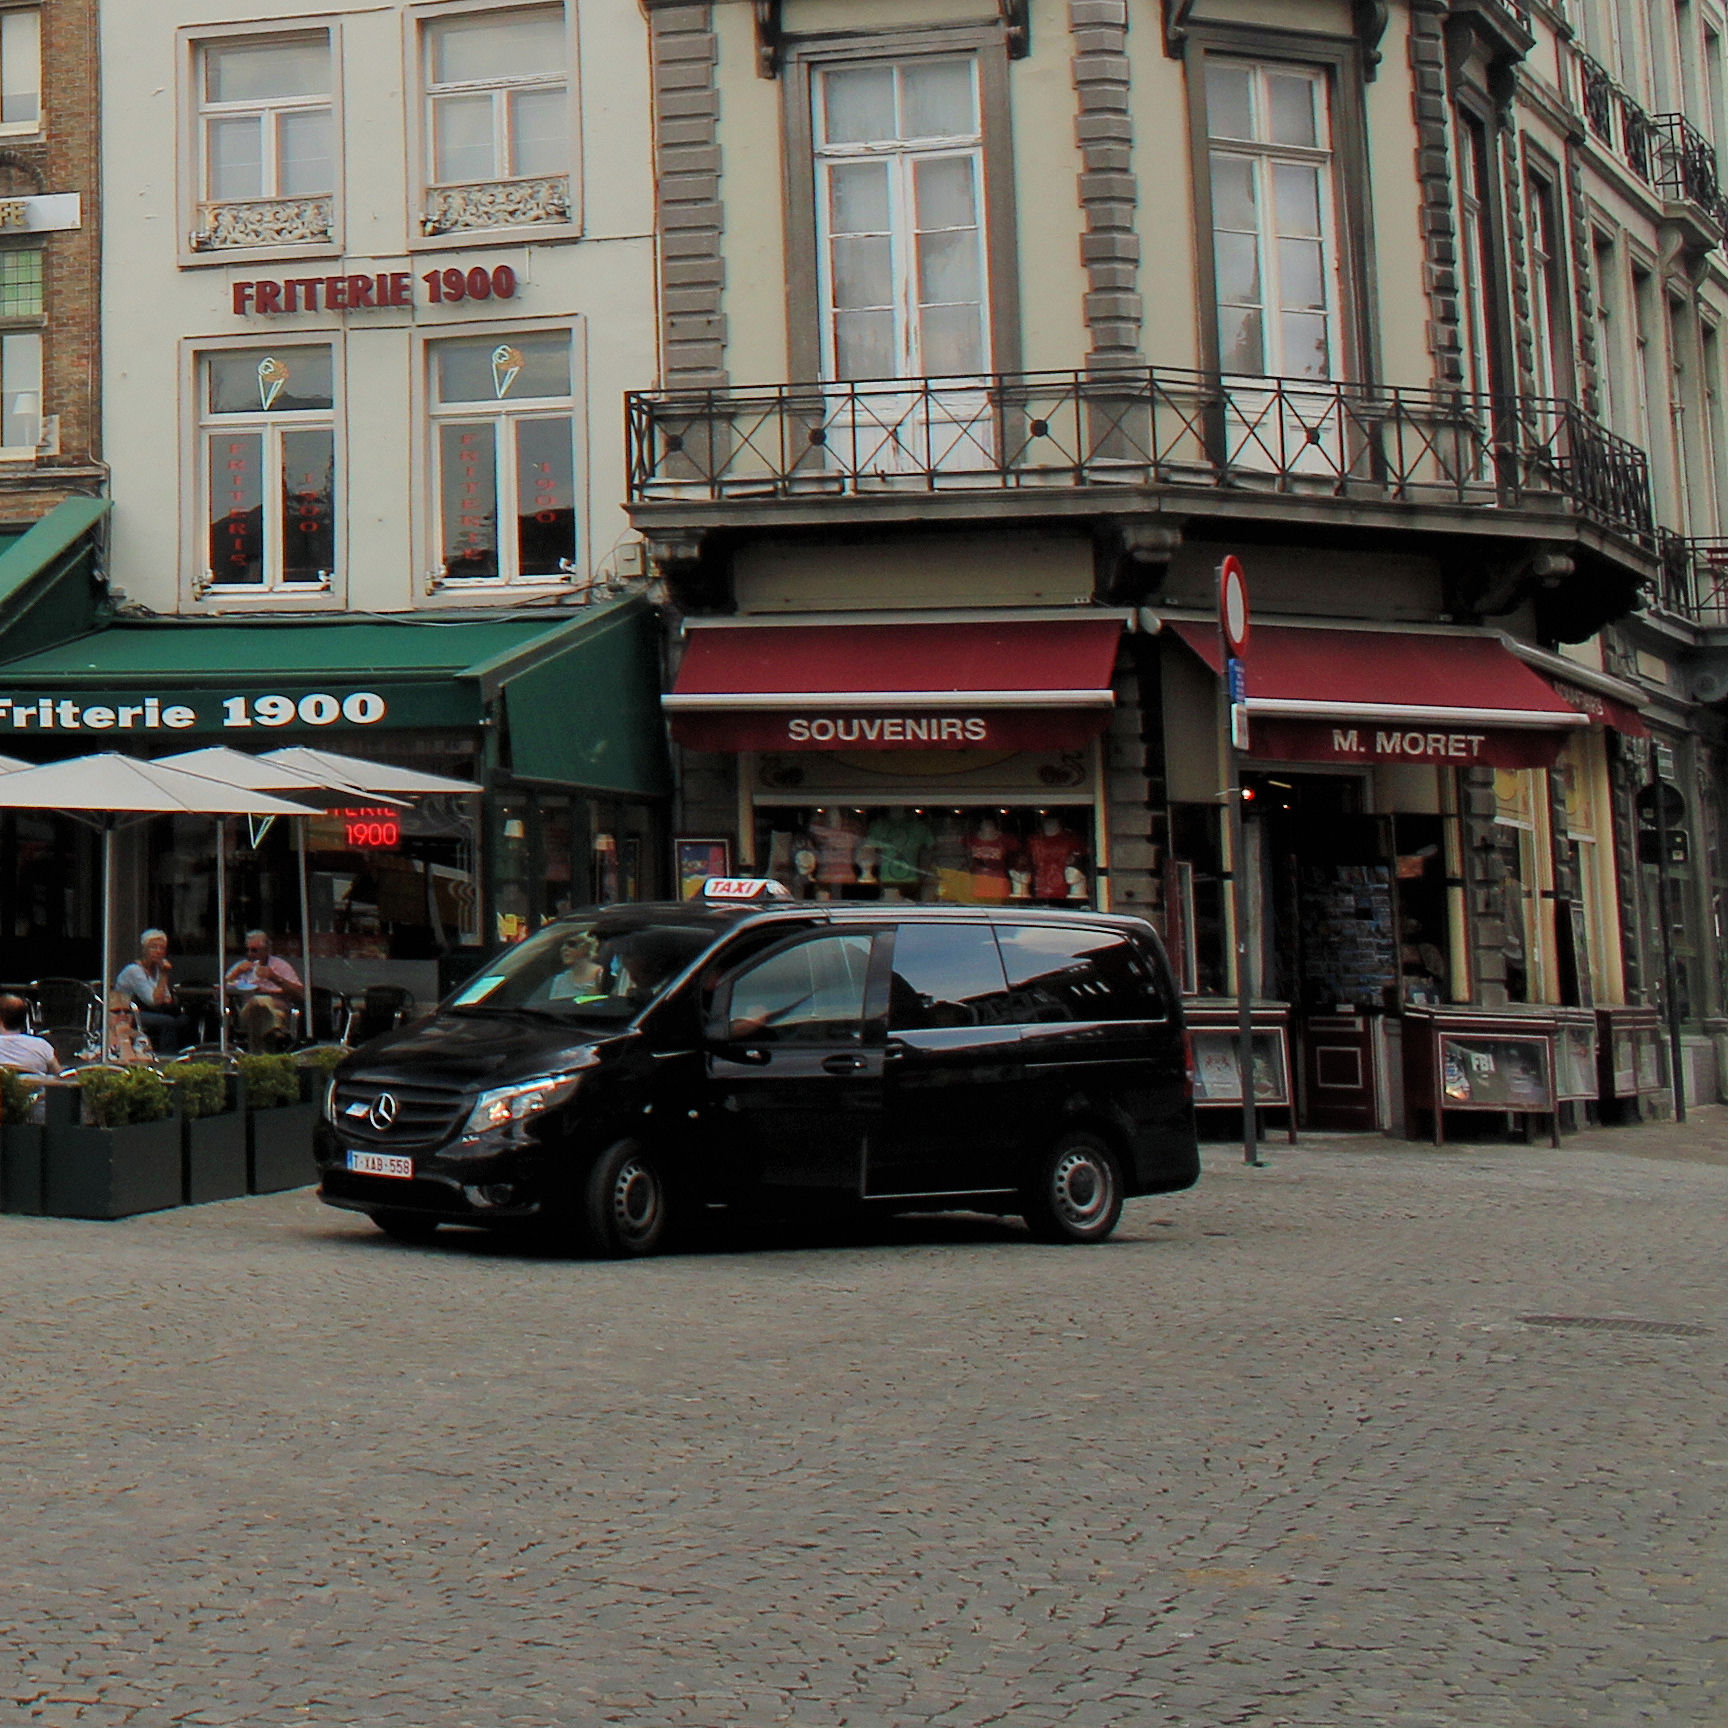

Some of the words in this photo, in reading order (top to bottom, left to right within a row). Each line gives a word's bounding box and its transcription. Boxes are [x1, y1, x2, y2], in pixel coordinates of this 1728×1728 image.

[232, 272, 413, 315] FRITERIE
[422, 265, 516, 303] 1900
[222, 692, 387, 728] 1900
[788, 718, 987, 741] SOUVENIRS
[1332, 729, 1366, 753] M.
[1376, 730, 1486, 757] MORET
[345, 823, 397, 846] 1900
[711, 881, 754, 894] TAXI
[1471, 1053, 1495, 1072] FBI
[353, 1154, 411, 1175] T-XAB-558
